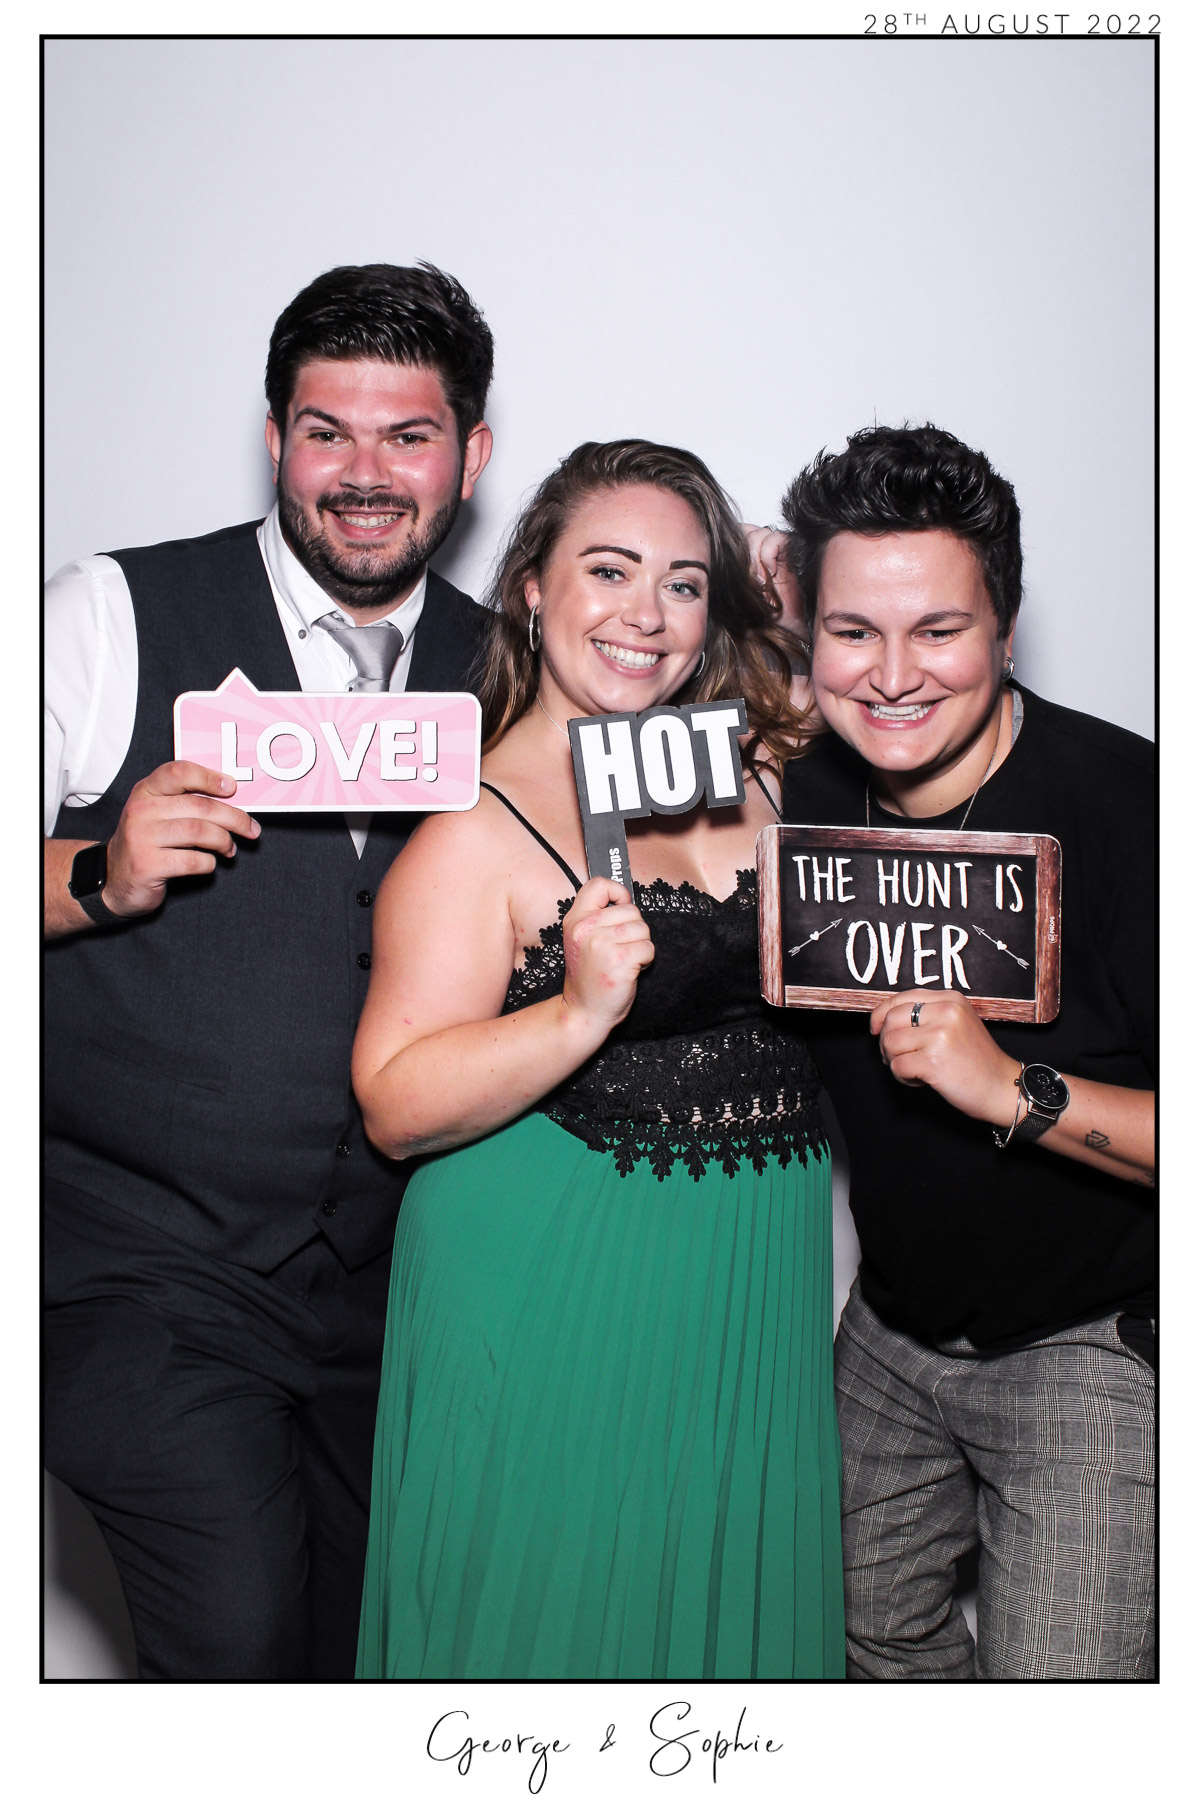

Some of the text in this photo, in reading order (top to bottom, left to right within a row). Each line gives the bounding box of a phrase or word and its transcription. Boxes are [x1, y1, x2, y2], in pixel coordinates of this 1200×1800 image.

[221, 720, 438, 782] LOVE!
[578, 708, 740, 815] HOT
[609, 847, 624, 885] Props
[792, 855, 1024, 912] THE HUNT IS
[846, 920, 971, 989] OVER
